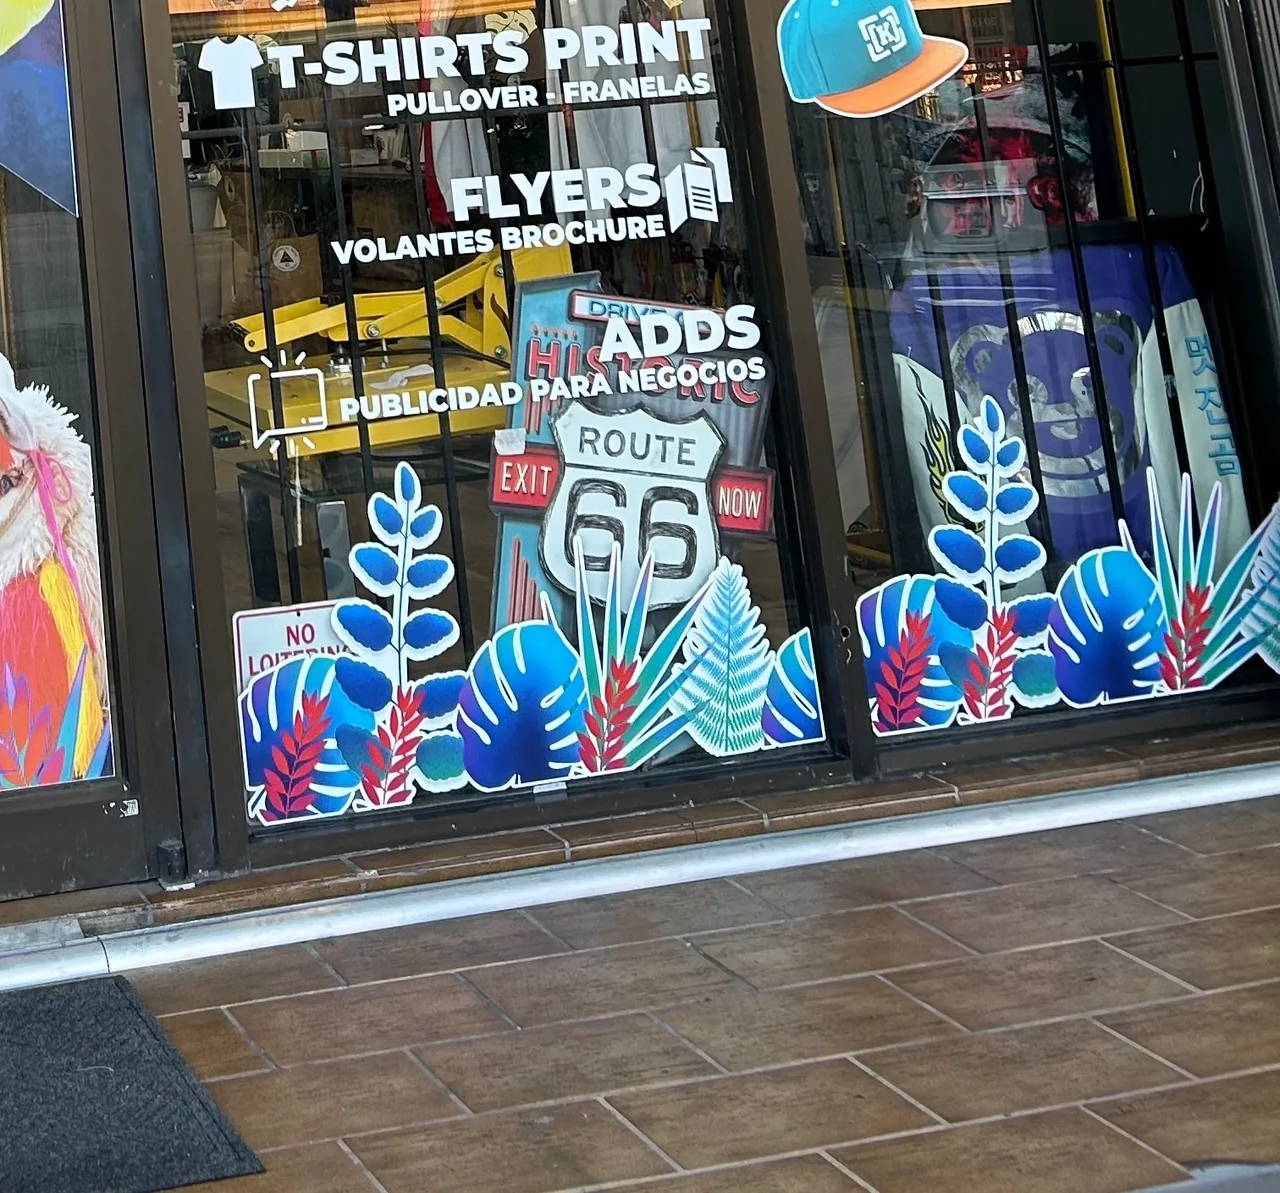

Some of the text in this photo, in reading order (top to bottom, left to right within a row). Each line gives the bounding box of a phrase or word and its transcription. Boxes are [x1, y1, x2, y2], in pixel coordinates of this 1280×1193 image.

[268, 18, 711, 89] T-SHIRTS PRINT
[387, 85, 538, 117] PULLOVER
[565, 73, 711, 104] FRANELAS
[451, 163, 661, 222] FLYERS
[332, 228, 494, 265] VOLANTES
[502, 213, 666, 251] BROCHURE
[599, 304, 761, 362] ADDS
[340, 357, 767, 421] PUBLICIDAD PARA NEGOCIOS
[579, 426, 696, 466] ROUTE
[501, 462, 552, 495] EXIT
[719, 486, 762, 519] NOW
[564, 478, 699, 580] 66
[286, 623, 315, 646] NO
